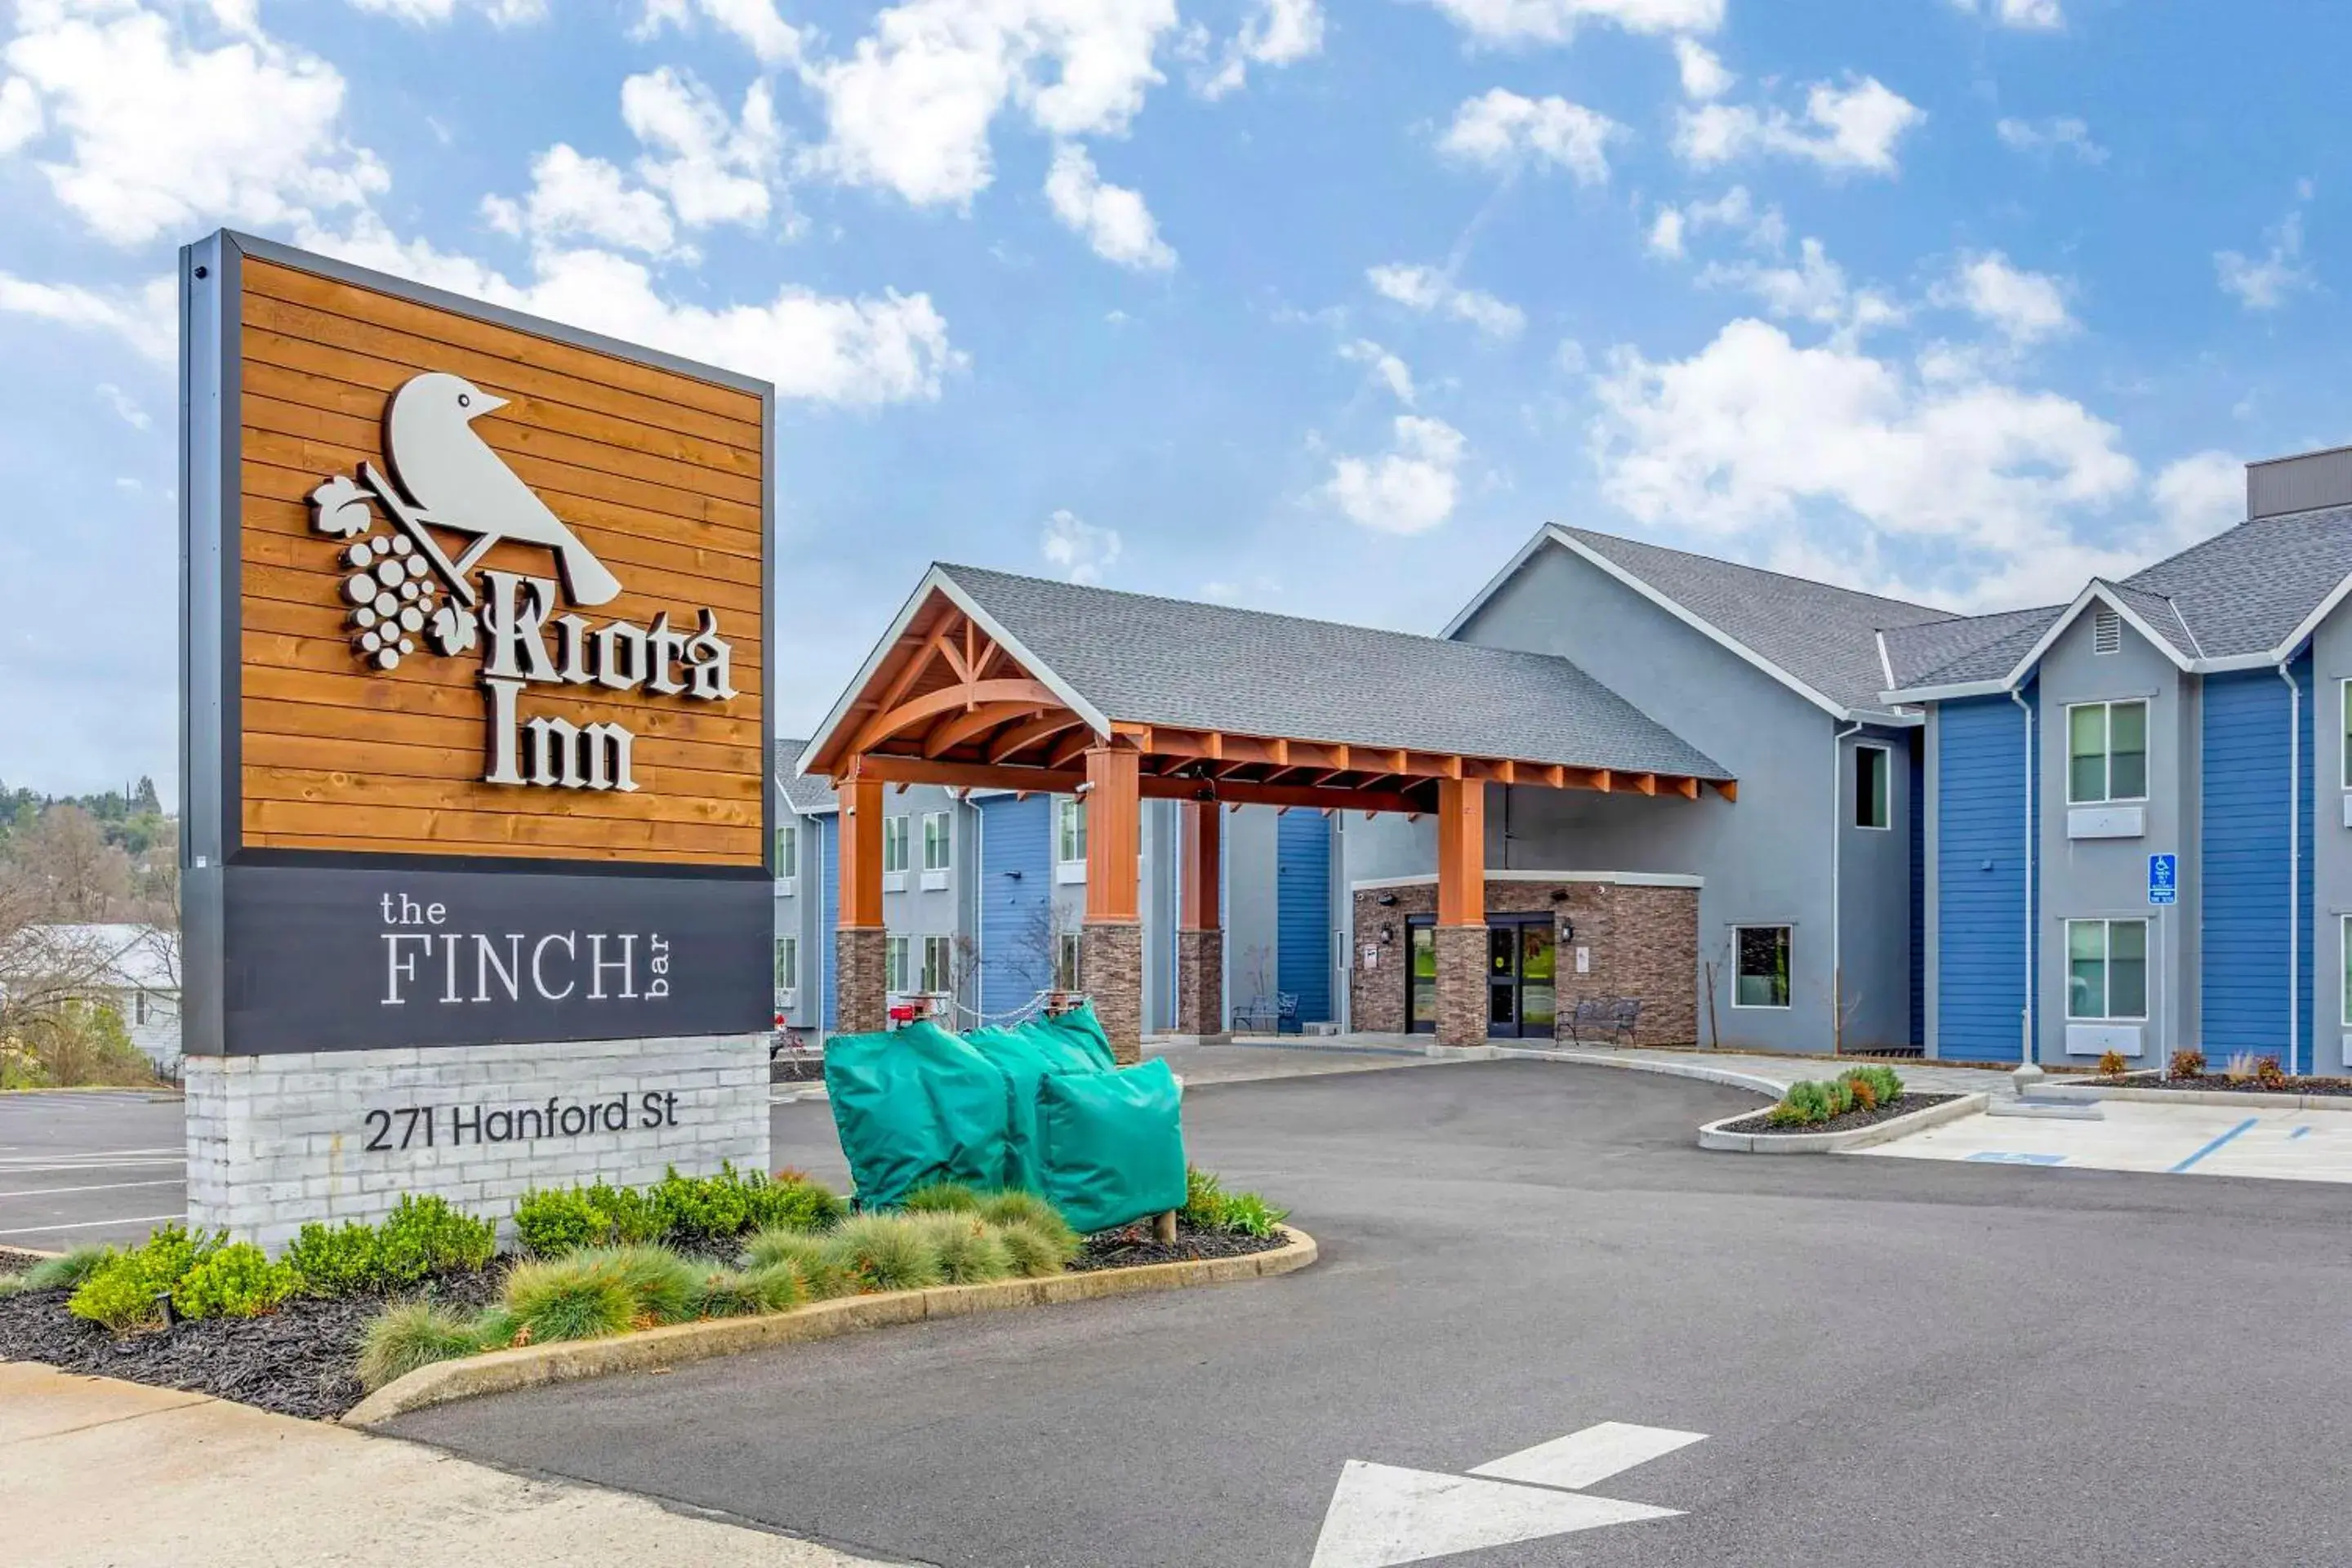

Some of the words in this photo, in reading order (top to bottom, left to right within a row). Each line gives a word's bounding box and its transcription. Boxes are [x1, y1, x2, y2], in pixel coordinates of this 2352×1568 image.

[485, 678, 640, 792] Inn
[381, 893, 447, 924] the
[381, 931, 639, 1005] FINCH
[644, 933, 670, 1000] bar
[364, 1107, 434, 1152] 271
[453, 1092, 629, 1145] Hanford
[642, 1091, 679, 1129] St
